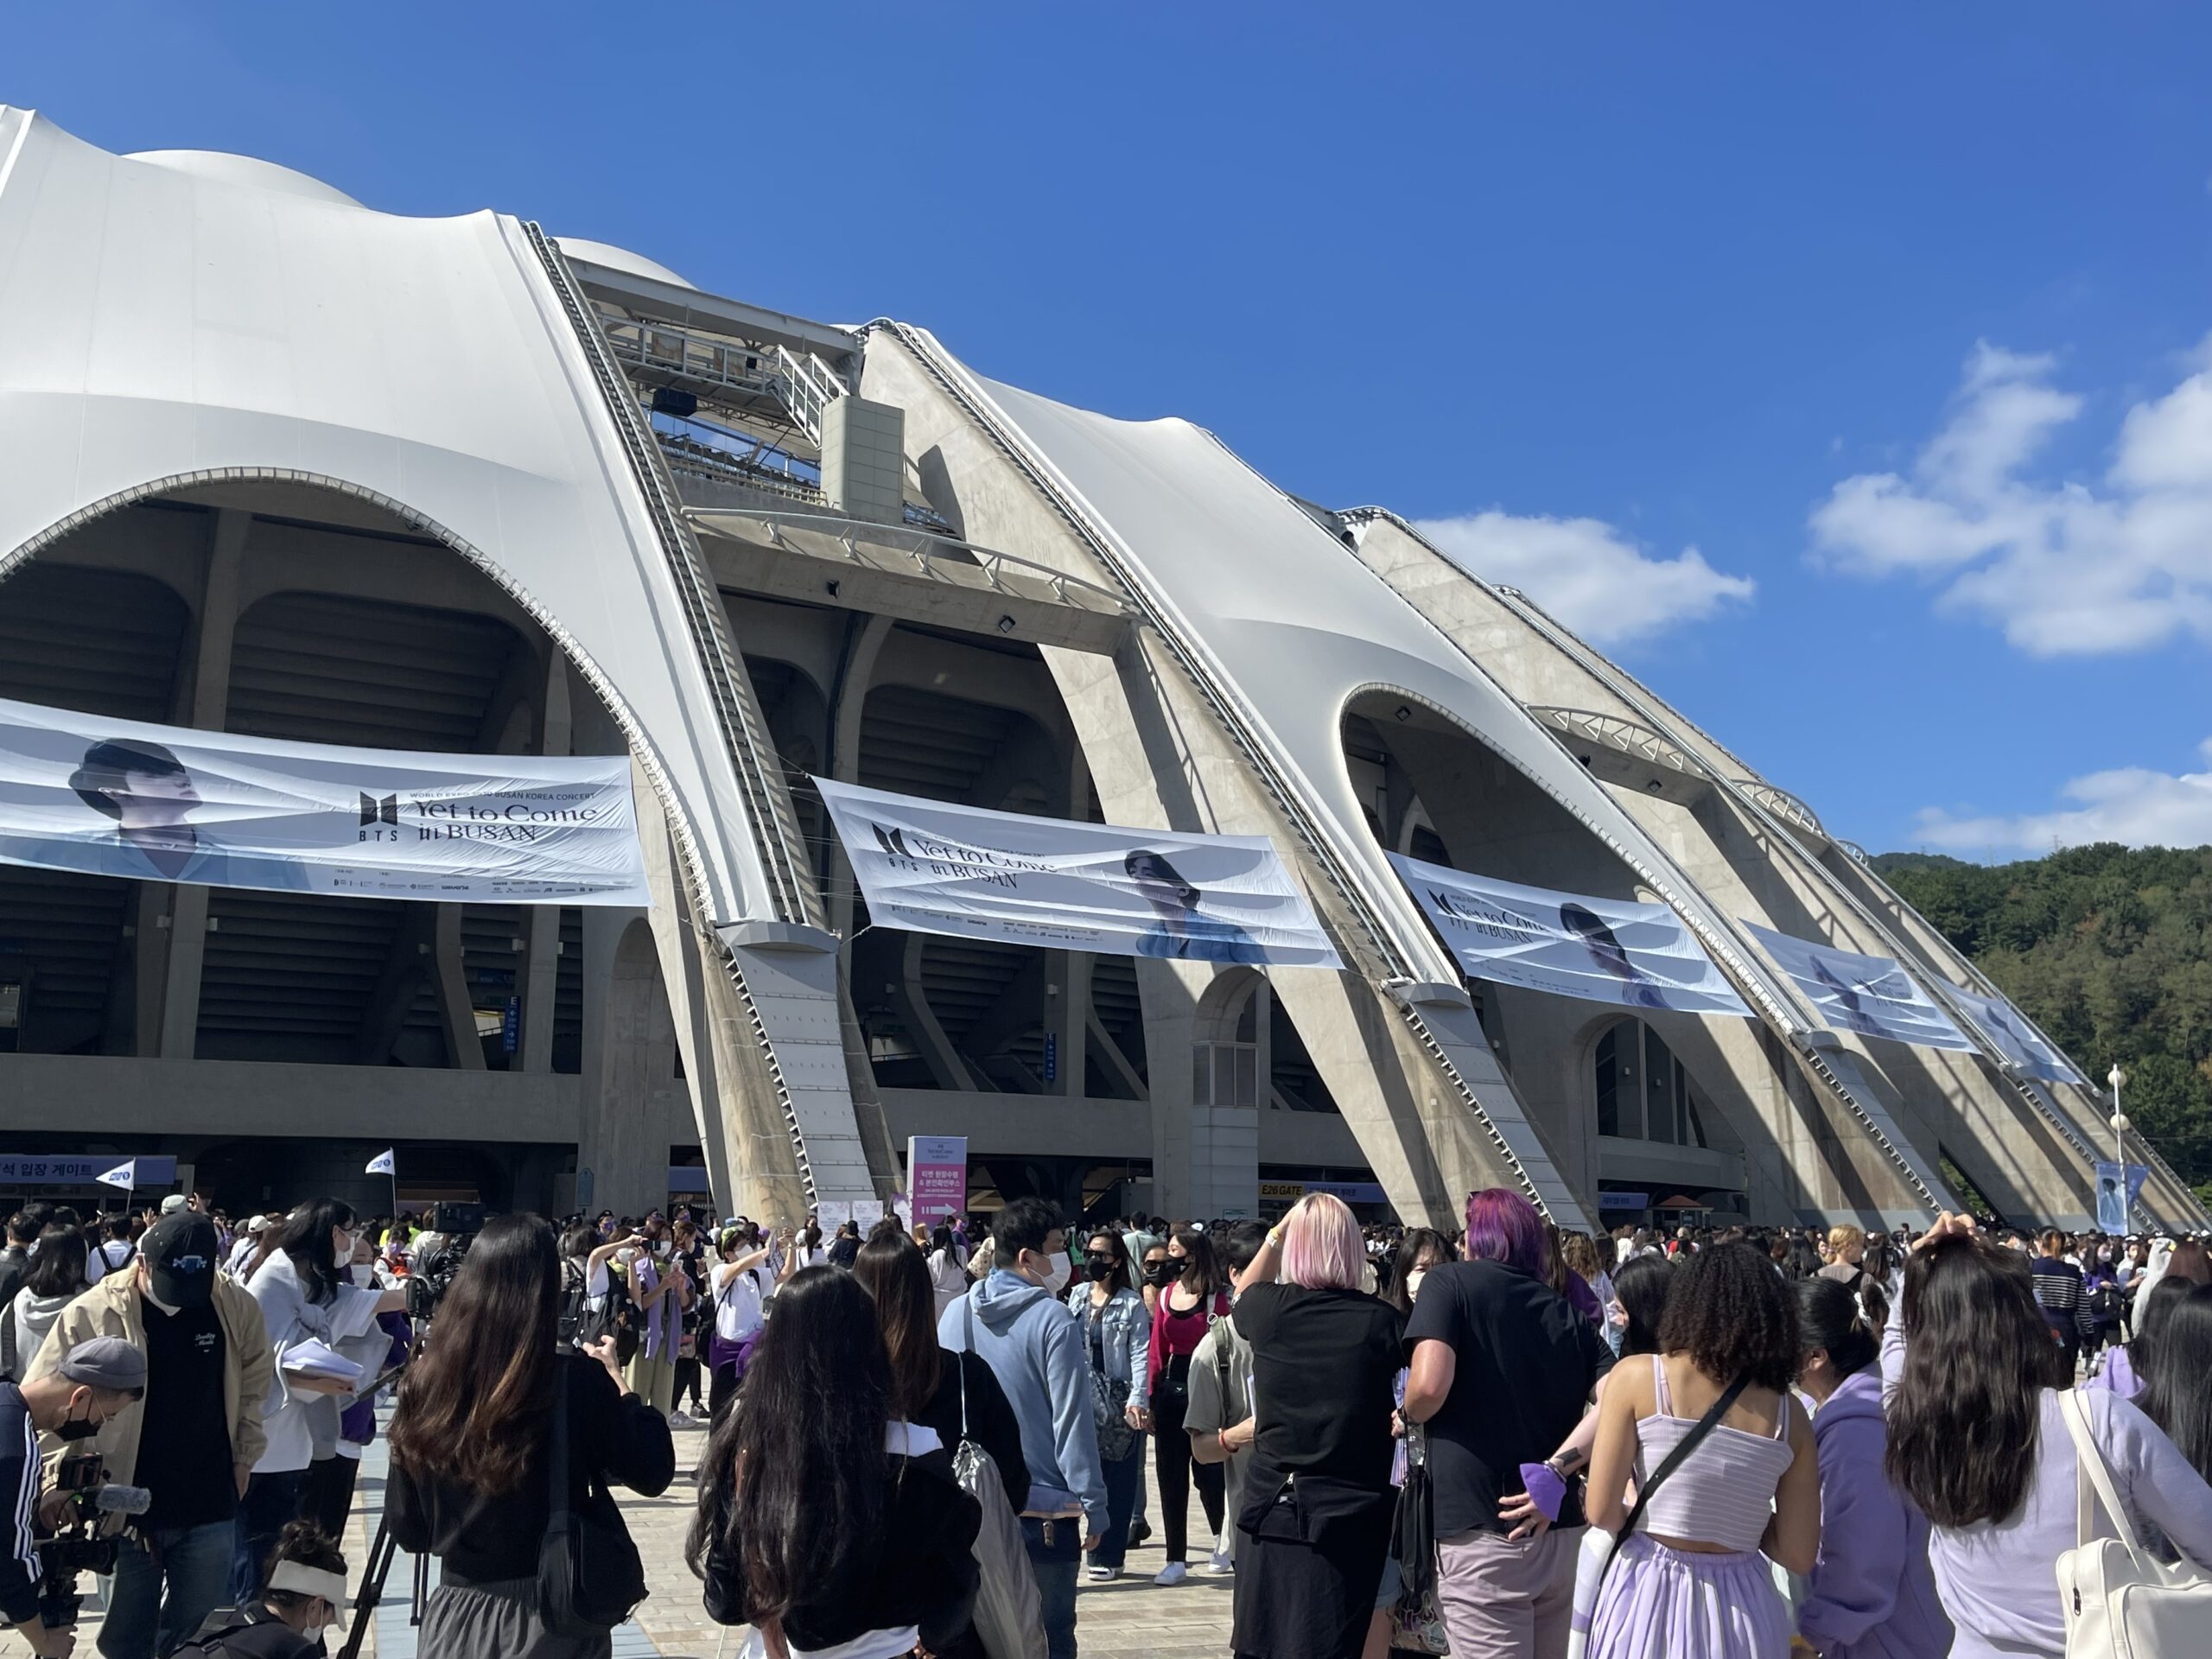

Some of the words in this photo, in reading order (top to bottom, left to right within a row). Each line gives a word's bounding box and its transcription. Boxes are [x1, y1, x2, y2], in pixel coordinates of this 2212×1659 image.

[415, 800, 462, 819] Yet
[469, 807, 498, 821] to
[505, 804, 598, 822] Come
[359, 830, 398, 842] BTS
[419, 823, 442, 842] in
[448, 824, 537, 842] BUSAN
[912, 839, 956, 861] Yet
[957, 849, 983, 863] to
[986, 853, 1058, 873] Come
[931, 861, 950, 876] in
[950, 863, 1018, 888] BUSAN
[1453, 902, 1484, 921] Yet
[1485, 912, 1504, 925] to
[1489, 924, 1534, 944] BUSAN
[0, 1163, 15, 1176] 석
[21, 1163, 47, 1176] 입장
[52, 1163, 92, 1176] 게이트
[1262, 1185, 1278, 1195] E26
[1279, 1185, 1303, 1196] GATE
